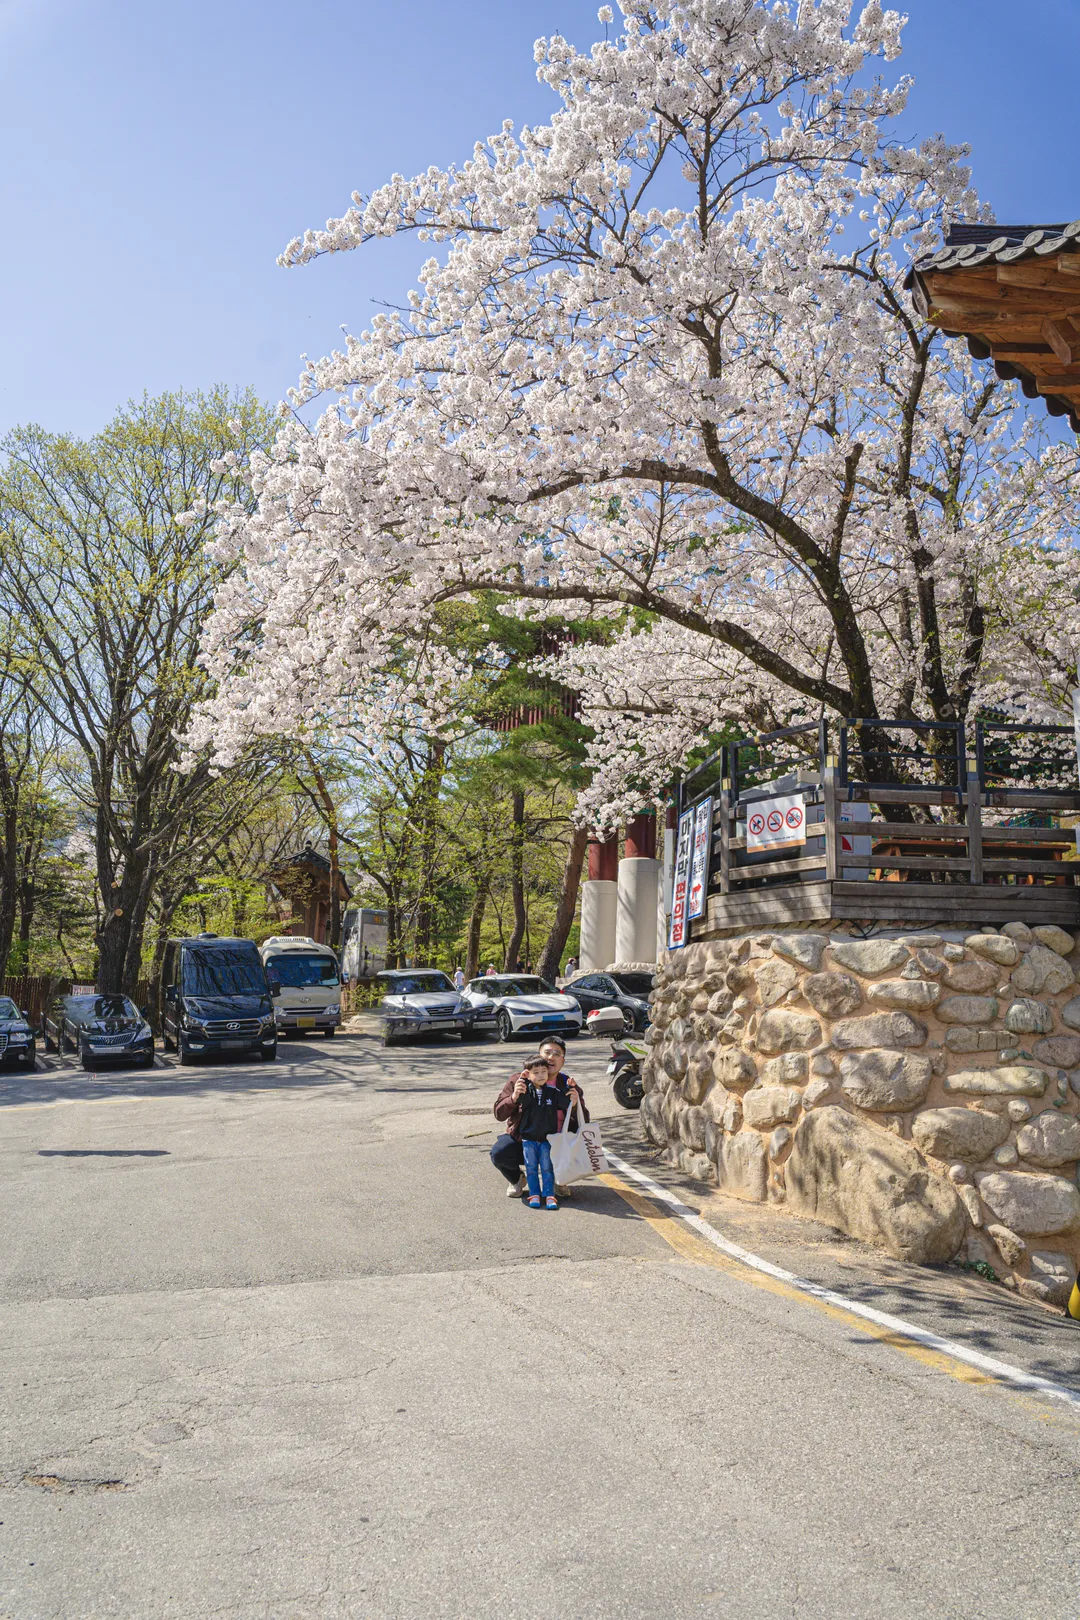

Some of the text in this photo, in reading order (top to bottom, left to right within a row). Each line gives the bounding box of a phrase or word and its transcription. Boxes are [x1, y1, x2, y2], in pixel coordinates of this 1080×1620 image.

[672, 817, 691, 942] 마지막 편의점
[582, 1130, 605, 1172] Entelon
